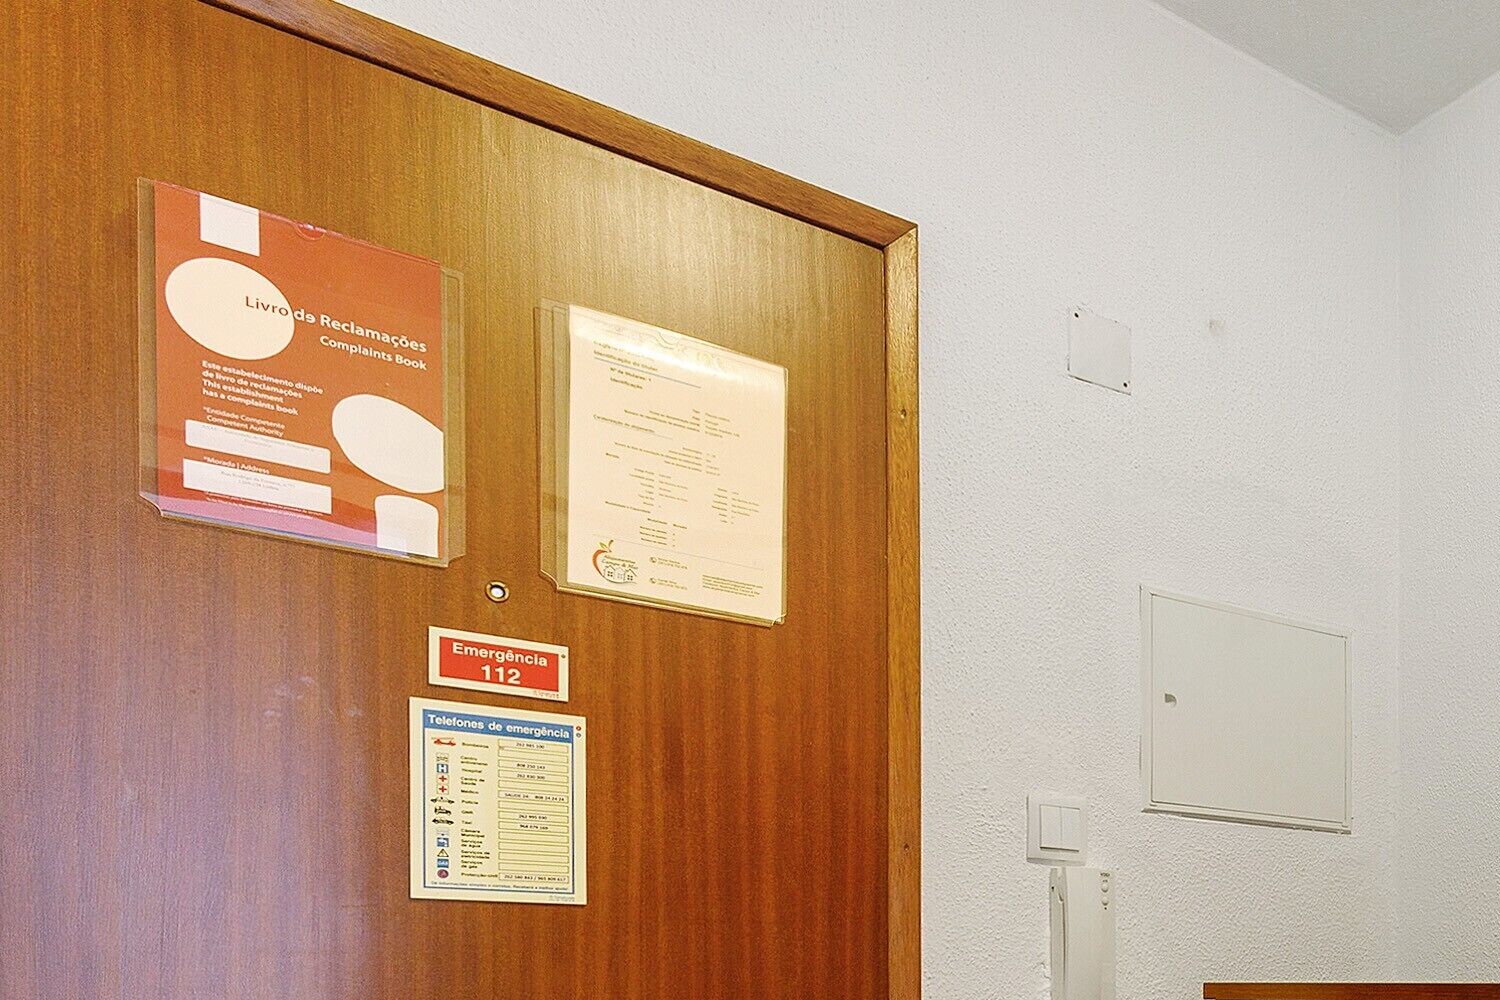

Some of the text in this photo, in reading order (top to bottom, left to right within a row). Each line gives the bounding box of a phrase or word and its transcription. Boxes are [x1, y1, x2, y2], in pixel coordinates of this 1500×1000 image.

[245, 296, 428, 353] Livro de Reclamações
[320, 335, 428, 371] Complaints Book
[202, 360, 324, 395] Este estabelecimento dispõe
[202, 370, 303, 399] de livro de reclamações
[202, 379, 284, 404] This establishment
[202, 388, 218, 398] has
[226, 394, 276, 412] complaints
[276, 404, 299, 416] book
[452, 642, 548, 667] Emergência
[481, 664, 521, 685] 112
[428, 714, 570, 739] Telefones de emergência
